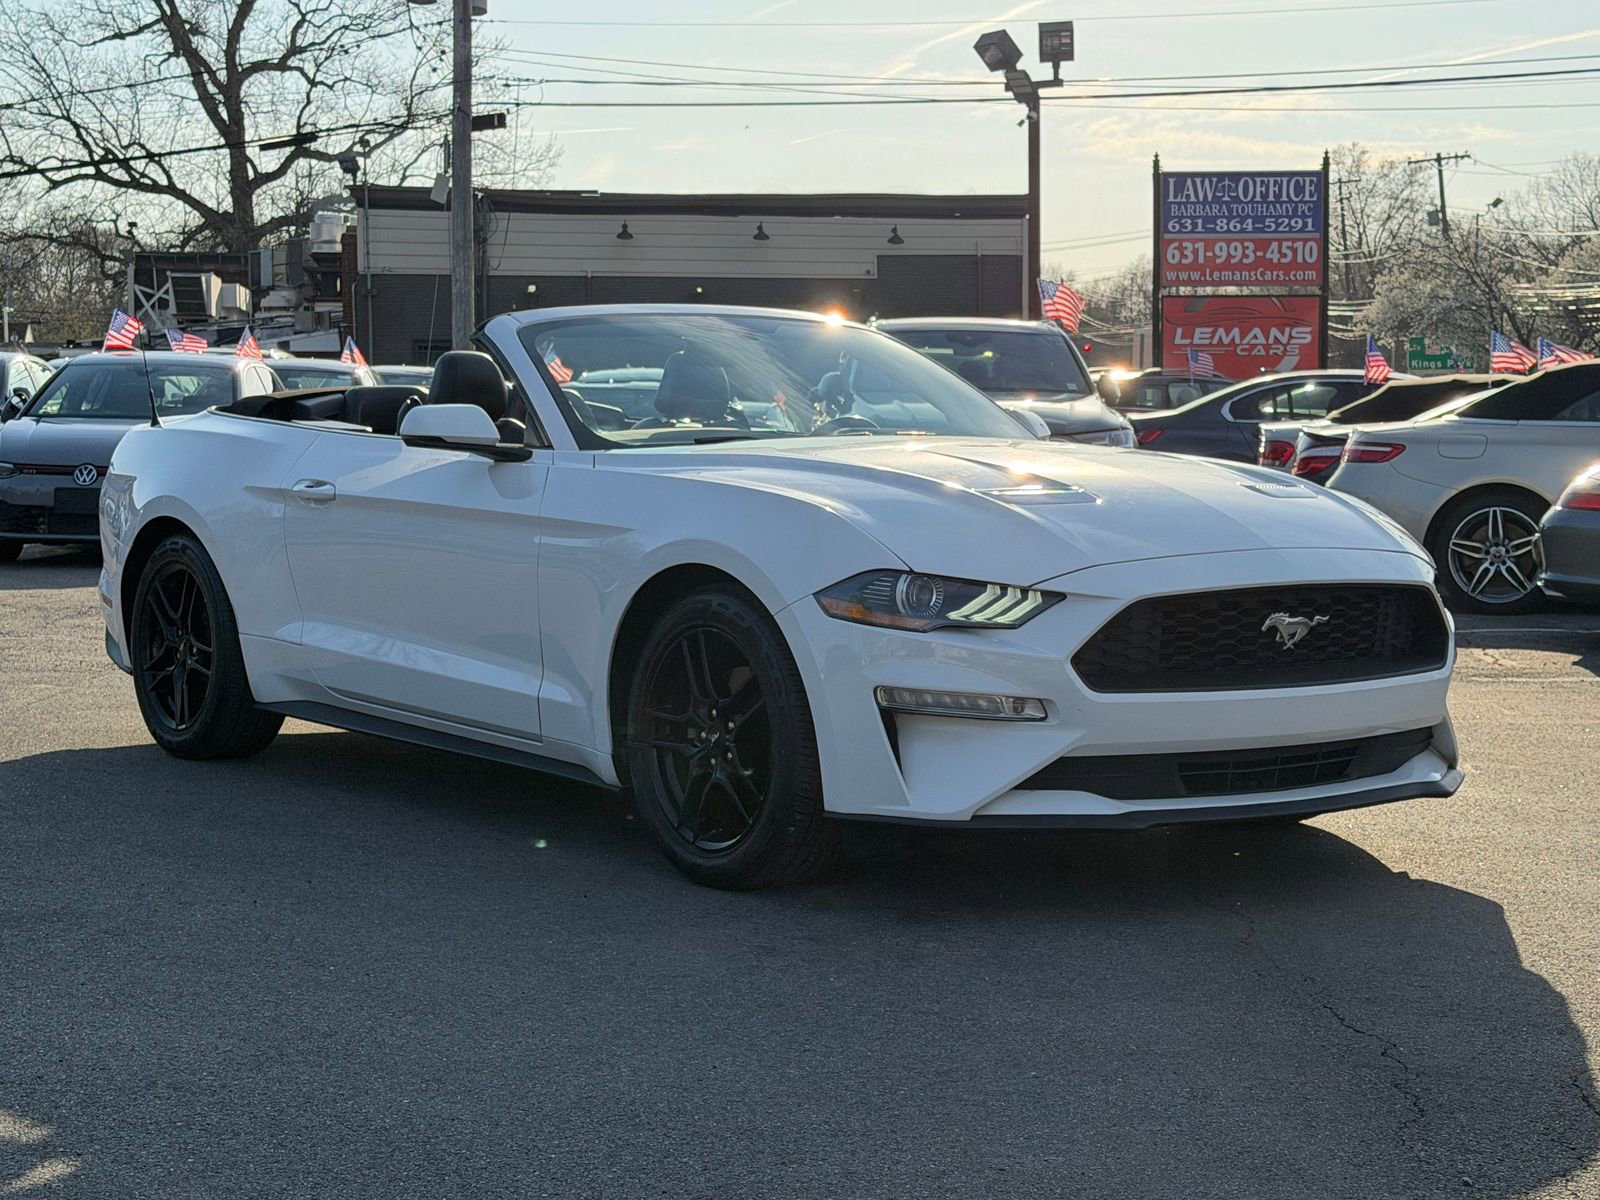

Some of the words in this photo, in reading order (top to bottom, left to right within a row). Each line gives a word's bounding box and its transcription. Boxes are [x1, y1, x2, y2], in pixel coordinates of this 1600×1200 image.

[1168, 178, 1217, 202] LAW
[1238, 177, 1317, 202] OFFICE
[1170, 204, 1228, 216] BARBARA
[1231, 204, 1296, 216] TOUHAMY
[1298, 204, 1313, 216] PC
[1168, 218, 1315, 232] 631-864-5291
[1166, 241, 1318, 264] 631-993-4510
[1166, 268, 1316, 282] www.LemansCars.com
[1174, 327, 1312, 345] LEMANS
[1236, 344, 1301, 356] CARS
[1411, 359, 1442, 369] Kings
